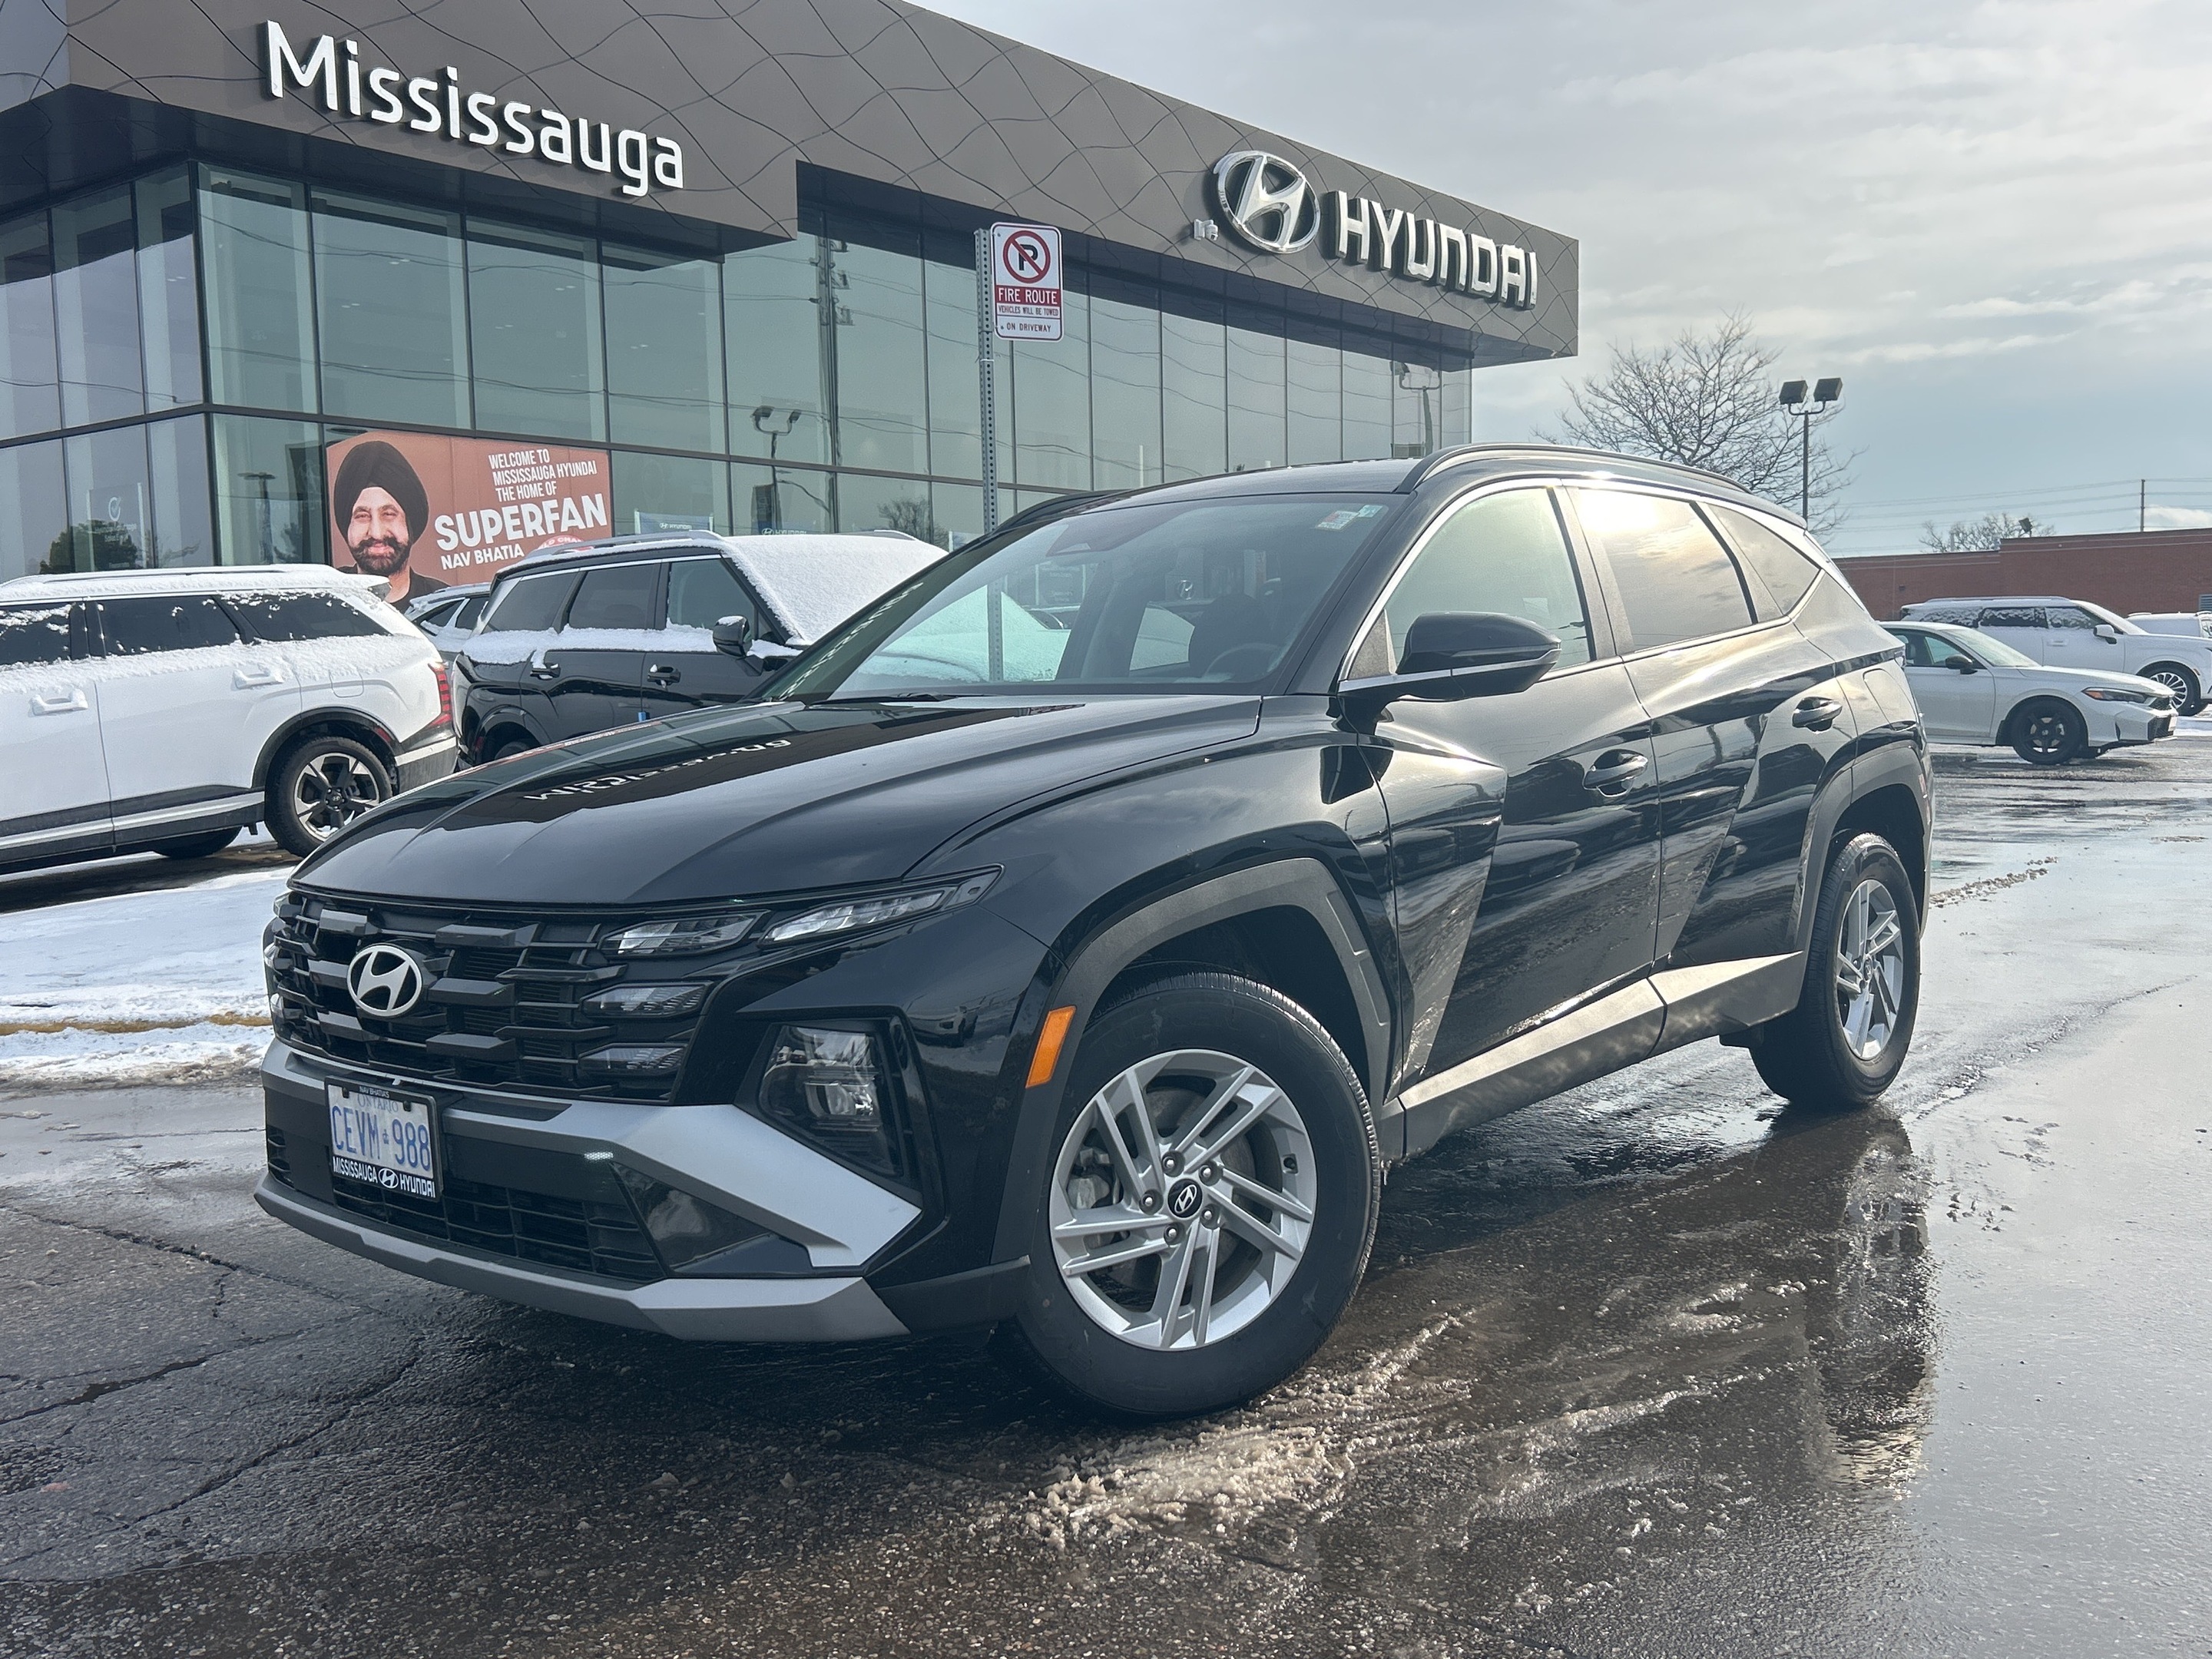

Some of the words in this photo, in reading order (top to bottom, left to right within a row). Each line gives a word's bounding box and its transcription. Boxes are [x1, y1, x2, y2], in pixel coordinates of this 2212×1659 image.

[265, 19, 684, 198] Mississauga
[1334, 190, 1538, 310] HYUNDAI
[998, 287, 1021, 303] FIRE
[1025, 289, 1058, 304] ROUTE
[998, 305, 1021, 314] VEHICLES
[1023, 306, 1034, 316] WILL
[1035, 307, 1041, 316] BE
[1044, 308, 1058, 316] TOWED
[1006, 322, 1016, 330] ON
[1019, 323, 1051, 333] DRIVEWAY
[488, 450, 536, 469] WELCOME
[536, 449, 550, 463] TO
[492, 465, 556, 486] MISSISSAUGA
[556, 460, 598, 478] HYUNDAI
[495, 486, 516, 502] THE
[516, 482, 545, 500] HOME
[545, 481, 558, 495] OF
[434, 493, 608, 551] SUPERFAN
[441, 551, 471, 570] NAV
[474, 543, 525, 565] BHATIA
[357, 1093, 399, 1114] ONTARIO
[332, 1105, 380, 1160] CEVM
[392, 1118, 431, 1171] 988
[333, 1156, 379, 1184] MISSISSAUGA
[399, 1173, 436, 1198] HYUNDAI
